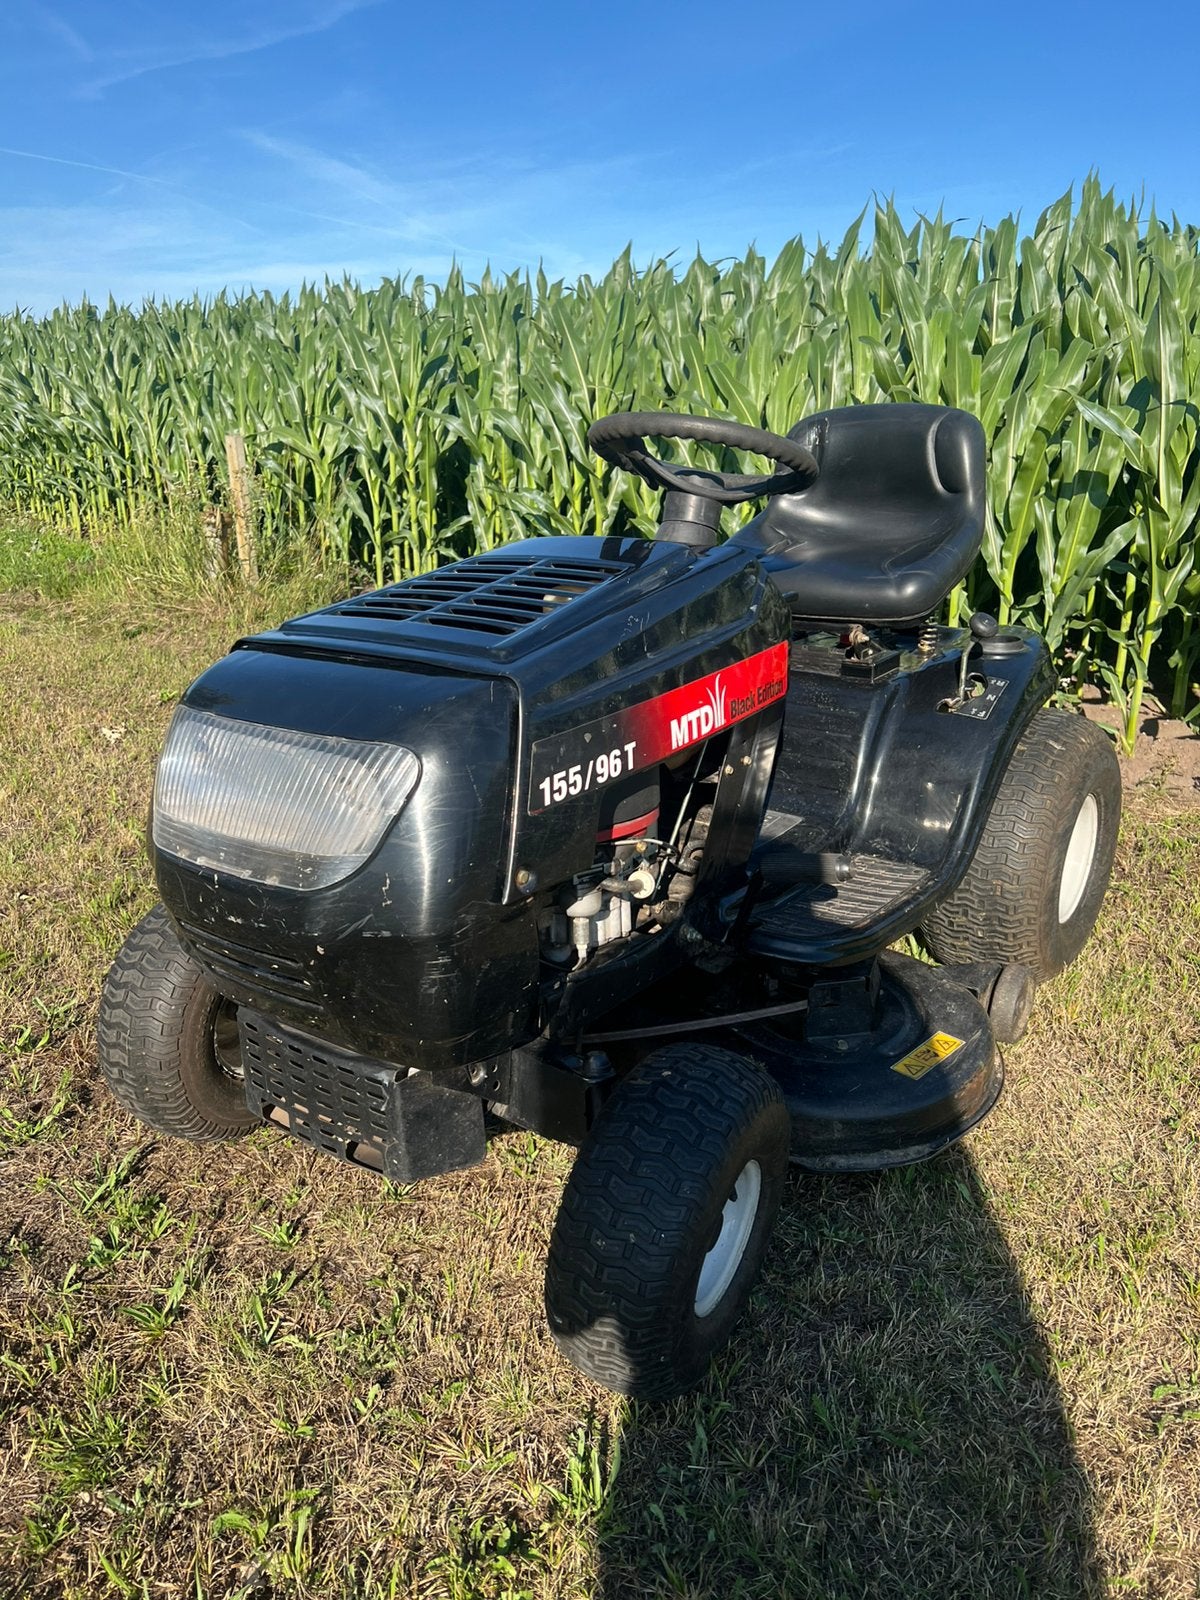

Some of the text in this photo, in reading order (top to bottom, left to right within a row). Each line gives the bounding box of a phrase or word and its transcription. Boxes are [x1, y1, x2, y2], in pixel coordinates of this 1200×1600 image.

[730, 679, 783, 719] Black Edition
[670, 704, 713, 750] MTD
